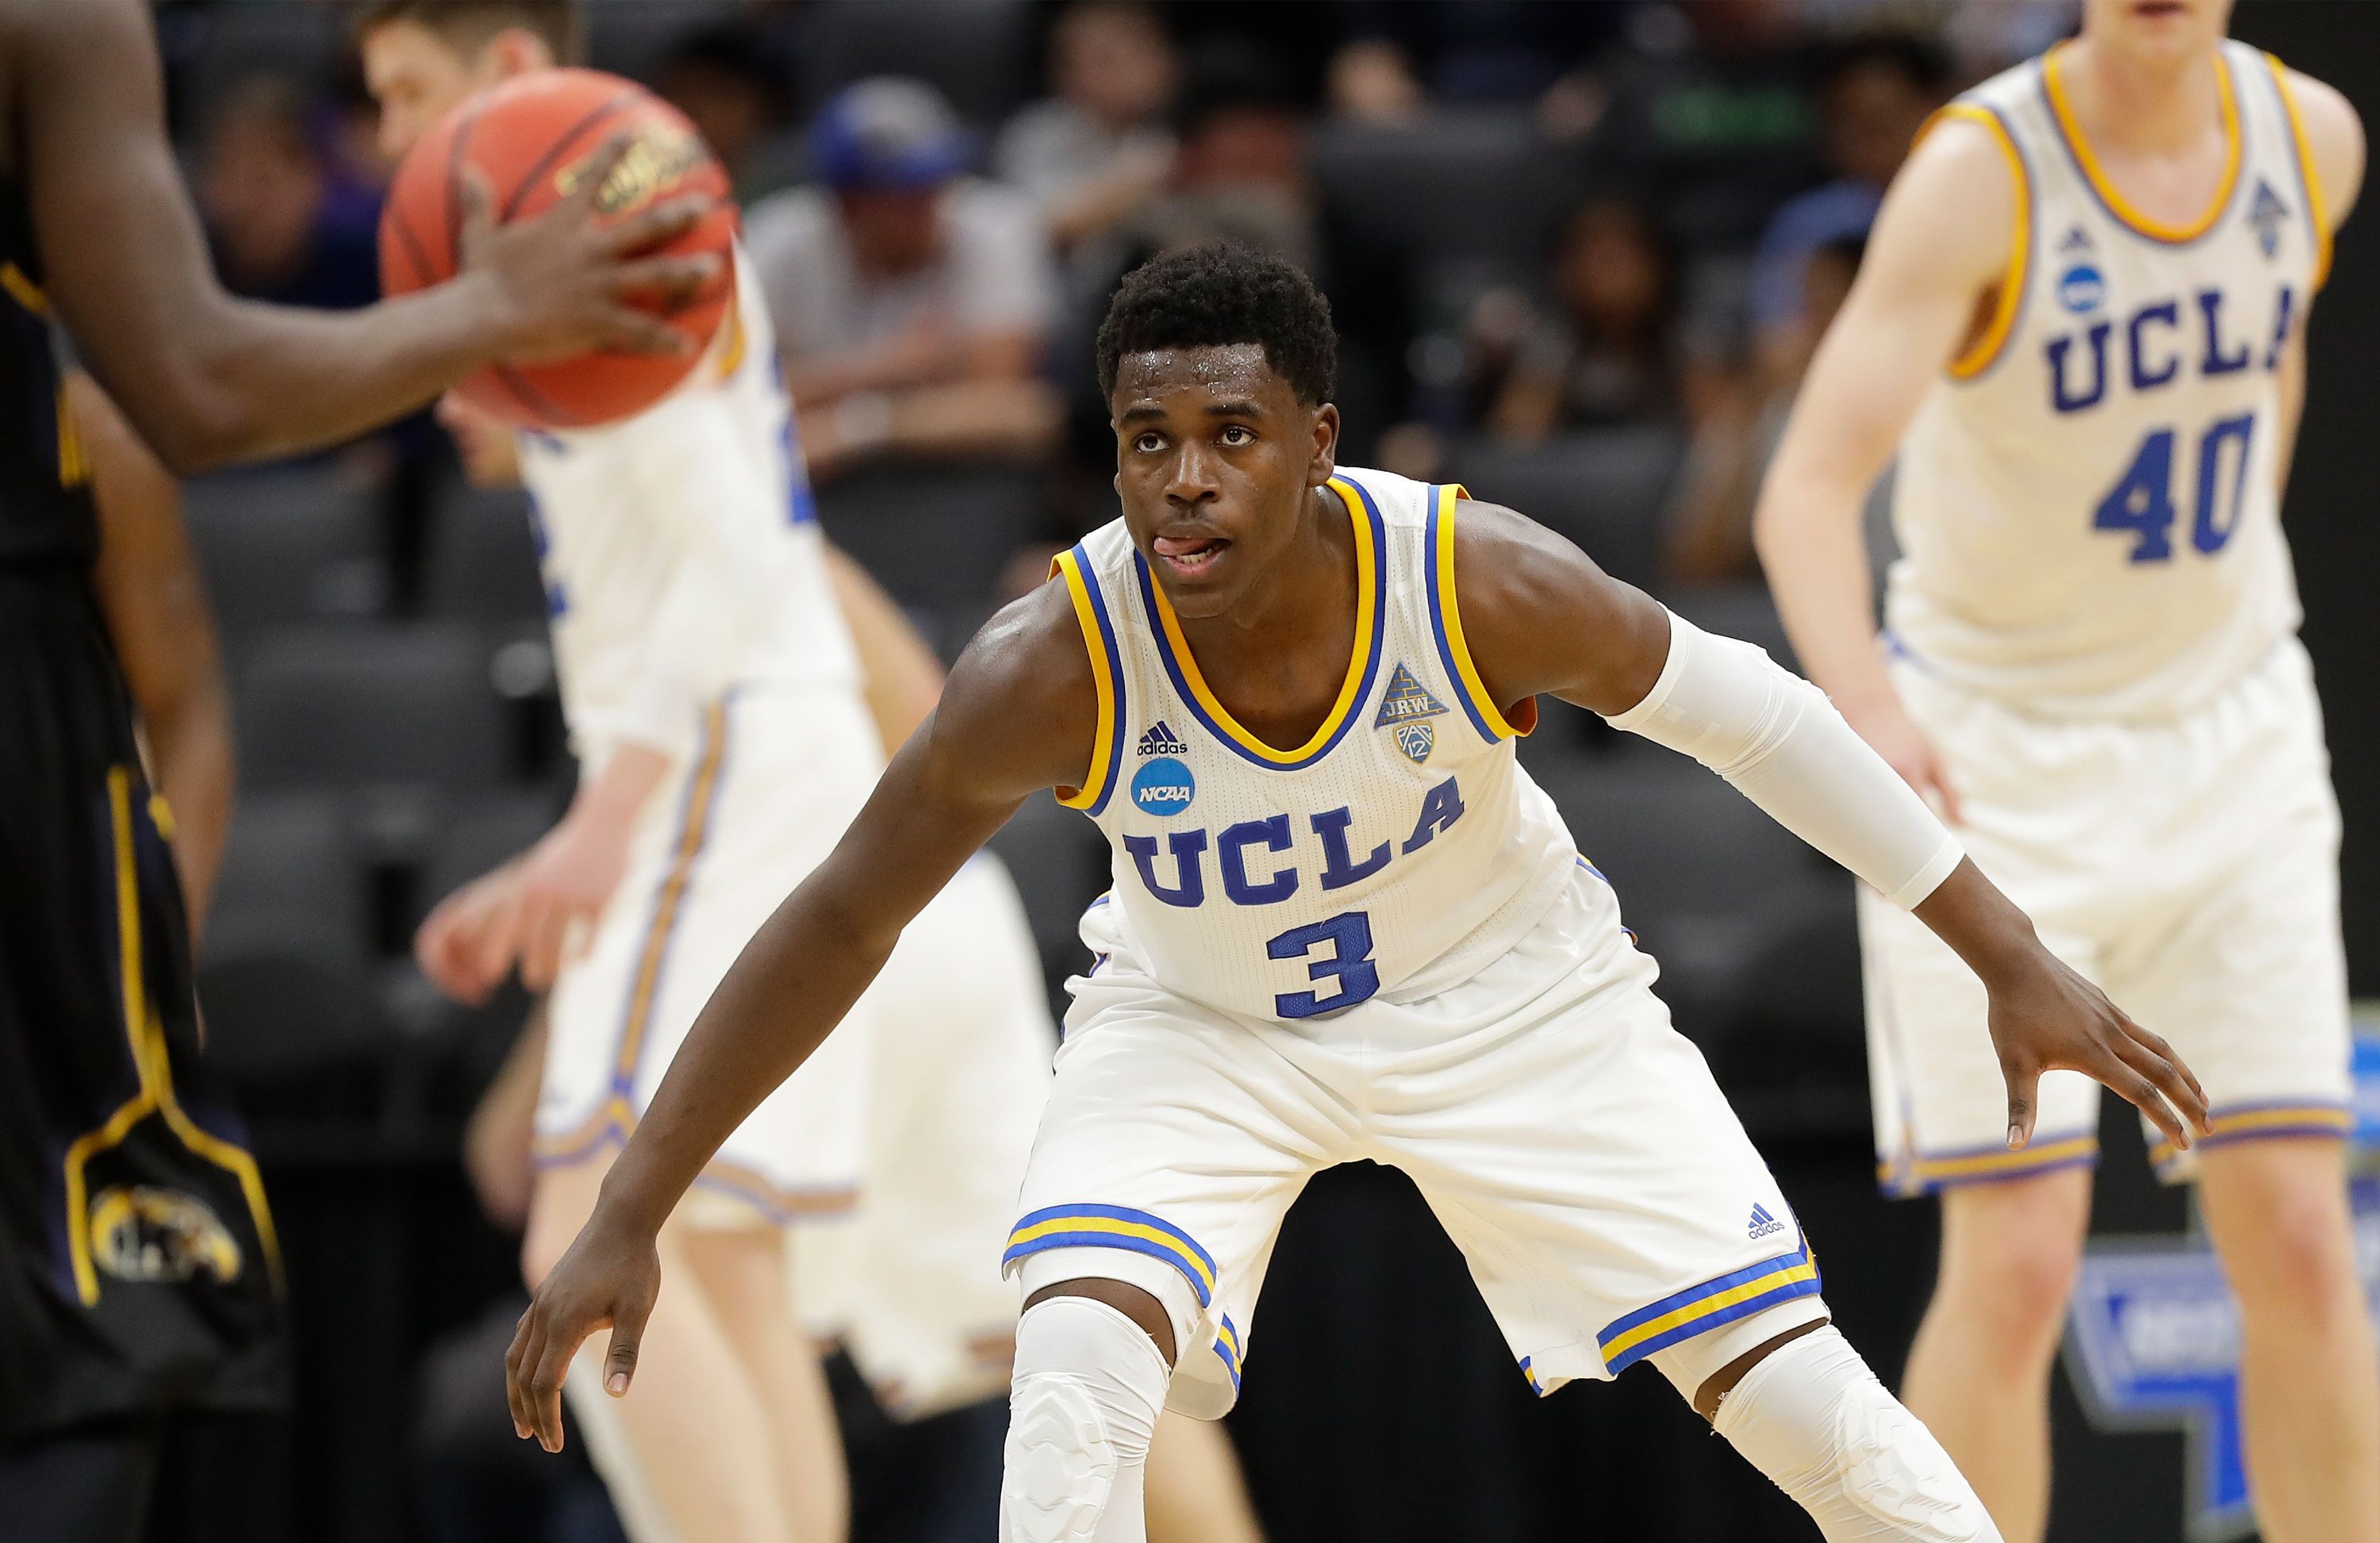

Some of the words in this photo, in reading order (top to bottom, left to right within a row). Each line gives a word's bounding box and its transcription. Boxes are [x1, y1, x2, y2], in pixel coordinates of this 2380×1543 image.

[2091, 413, 2255, 563] 40
[1386, 697, 1429, 716] JRW
[1137, 741, 1188, 756] adidas
[1407, 740, 1429, 758] 12
[1139, 786, 1190, 803] NCAA
[1123, 776, 1465, 908] UCLA
[1266, 911, 1381, 1019] 3
[1749, 1221, 1785, 1239] adidas
